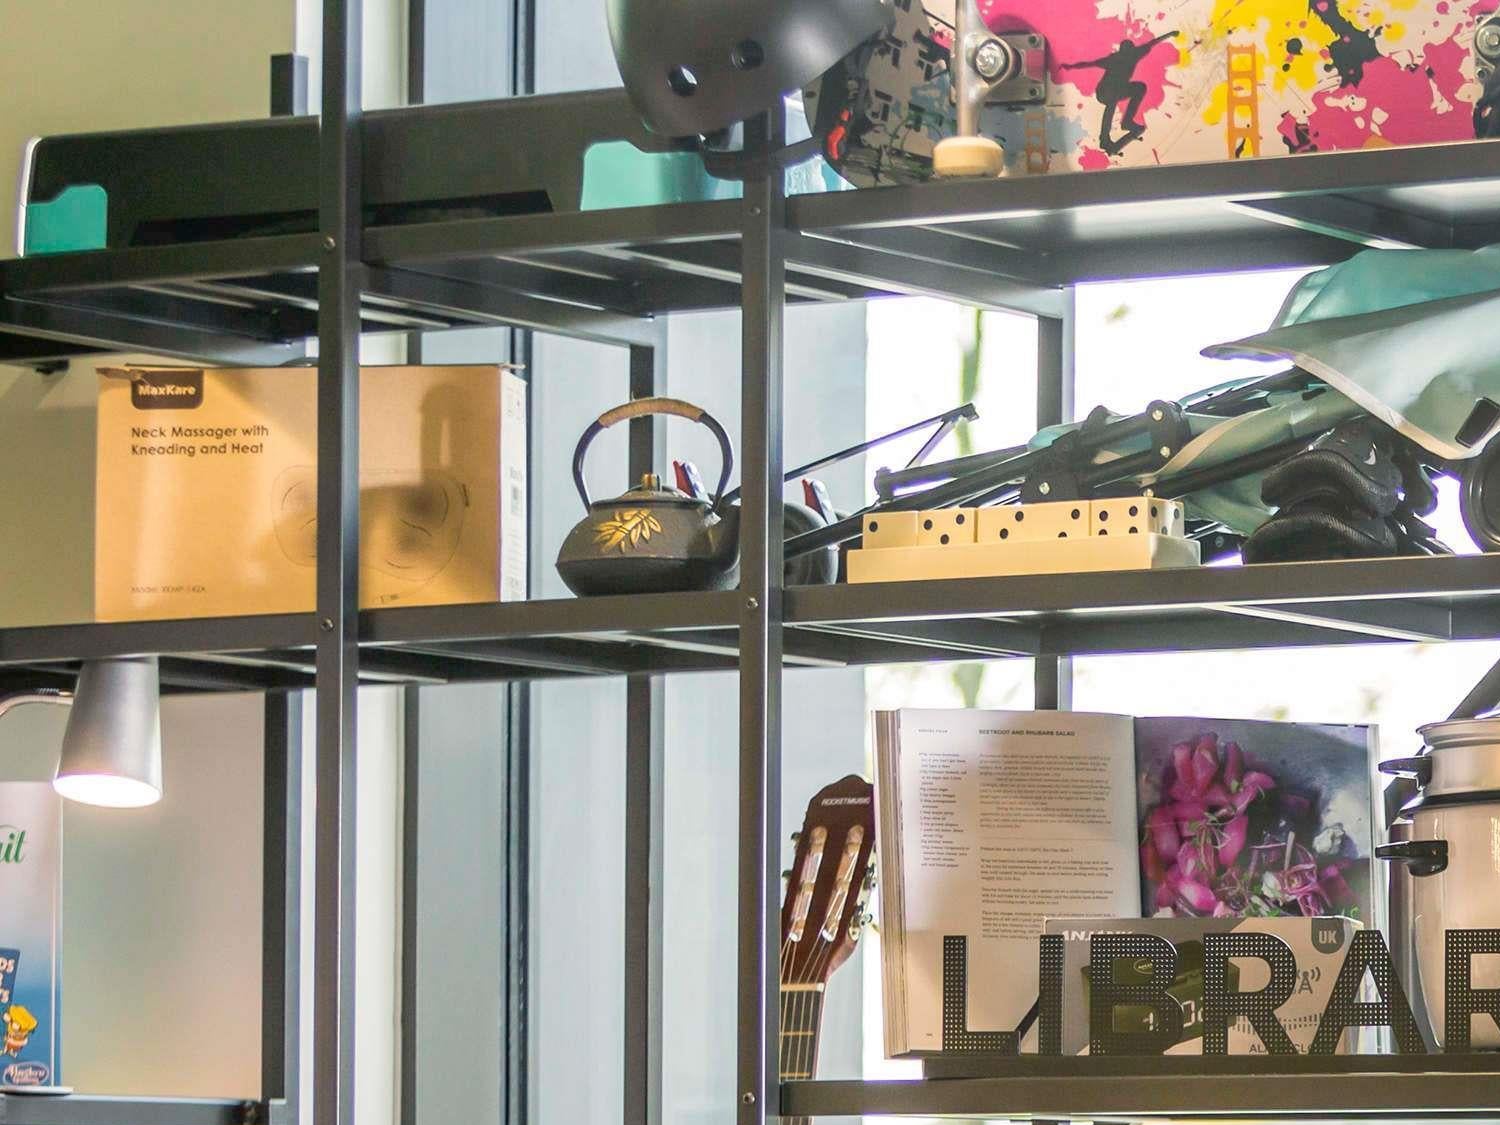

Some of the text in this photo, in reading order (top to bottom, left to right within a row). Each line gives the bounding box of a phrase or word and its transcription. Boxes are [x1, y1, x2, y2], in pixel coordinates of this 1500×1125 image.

[138, 384, 197, 397] MaxKare
[131, 425, 269, 440] Neck Massager with
[131, 443, 264, 457] Kneading and Heat
[1318, 930, 1338, 944] UK
